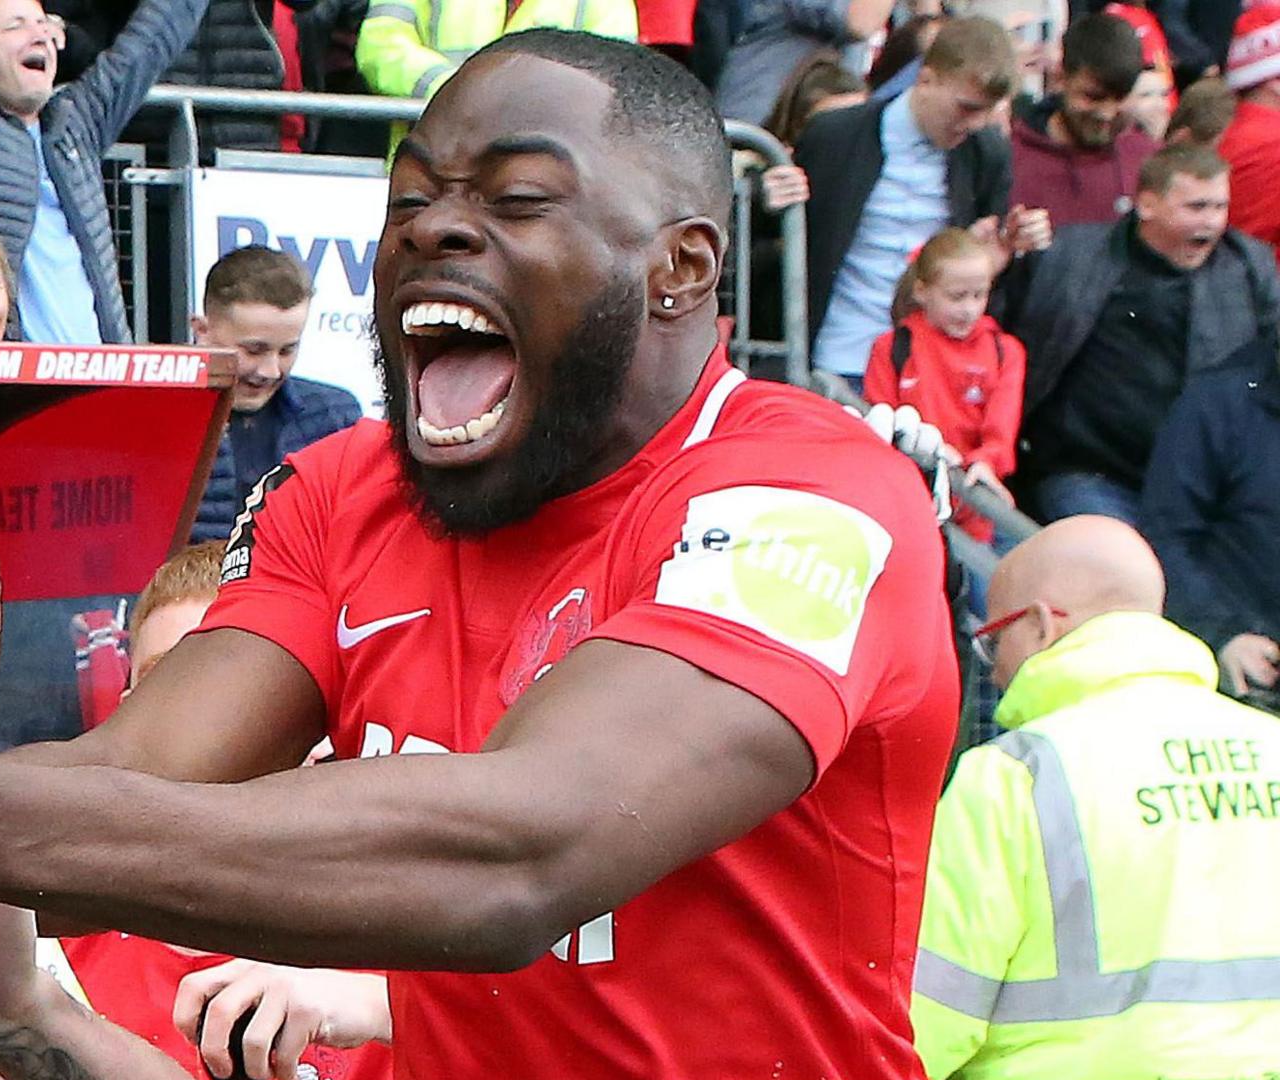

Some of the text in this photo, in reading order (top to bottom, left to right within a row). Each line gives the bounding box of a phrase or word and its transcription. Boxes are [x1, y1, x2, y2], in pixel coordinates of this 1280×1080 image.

[36, 352, 200, 383] DREAM TEAM
[1162, 739, 1260, 775] CHIEF
